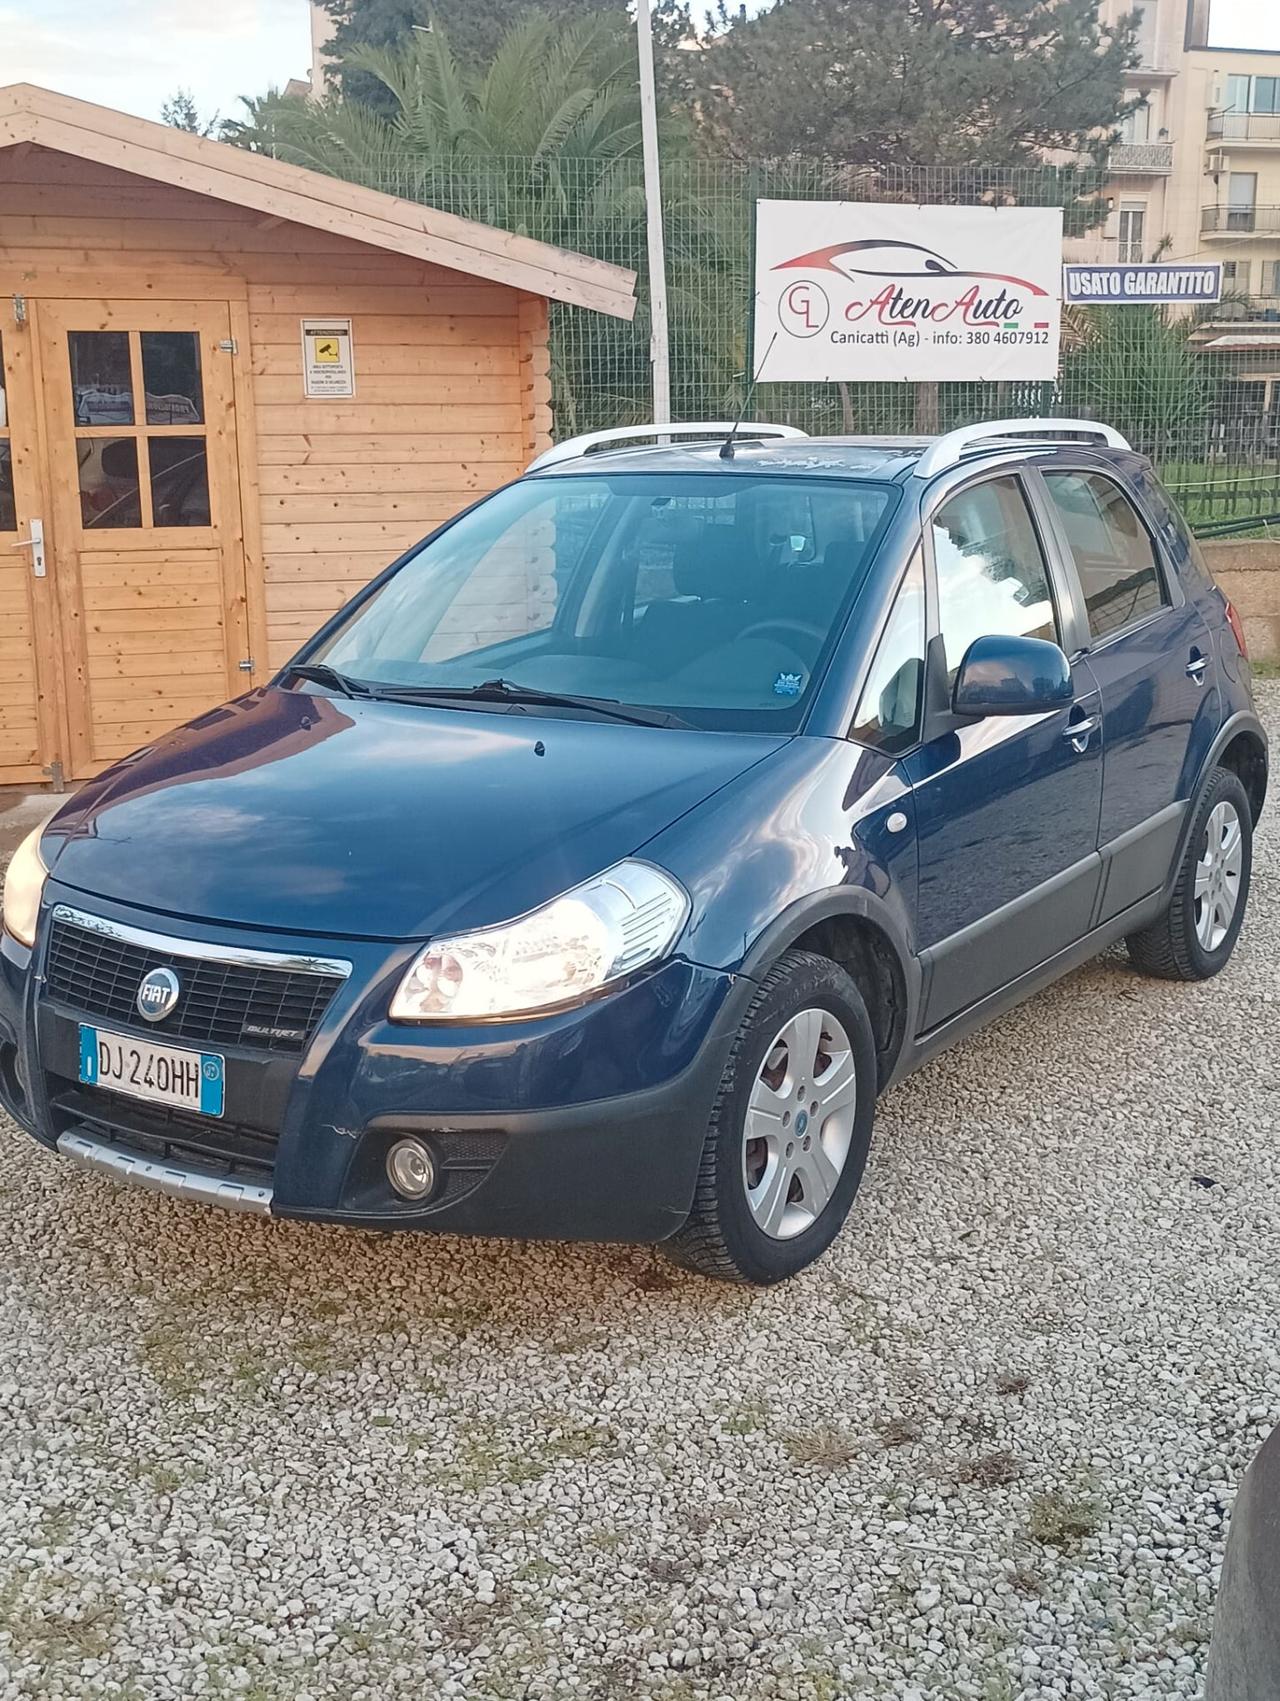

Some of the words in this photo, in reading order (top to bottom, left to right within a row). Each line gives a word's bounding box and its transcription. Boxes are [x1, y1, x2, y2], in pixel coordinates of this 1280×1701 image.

[1069, 272, 1121, 296] USATO
[1124, 271, 1215, 295] GARANTITO
[893, 331, 920, 347] (Ag)
[932, 331, 962, 345] info:
[966, 331, 990, 345] 380
[993, 331, 1049, 345] 4607912
[141, 983, 170, 1004] FIAT
